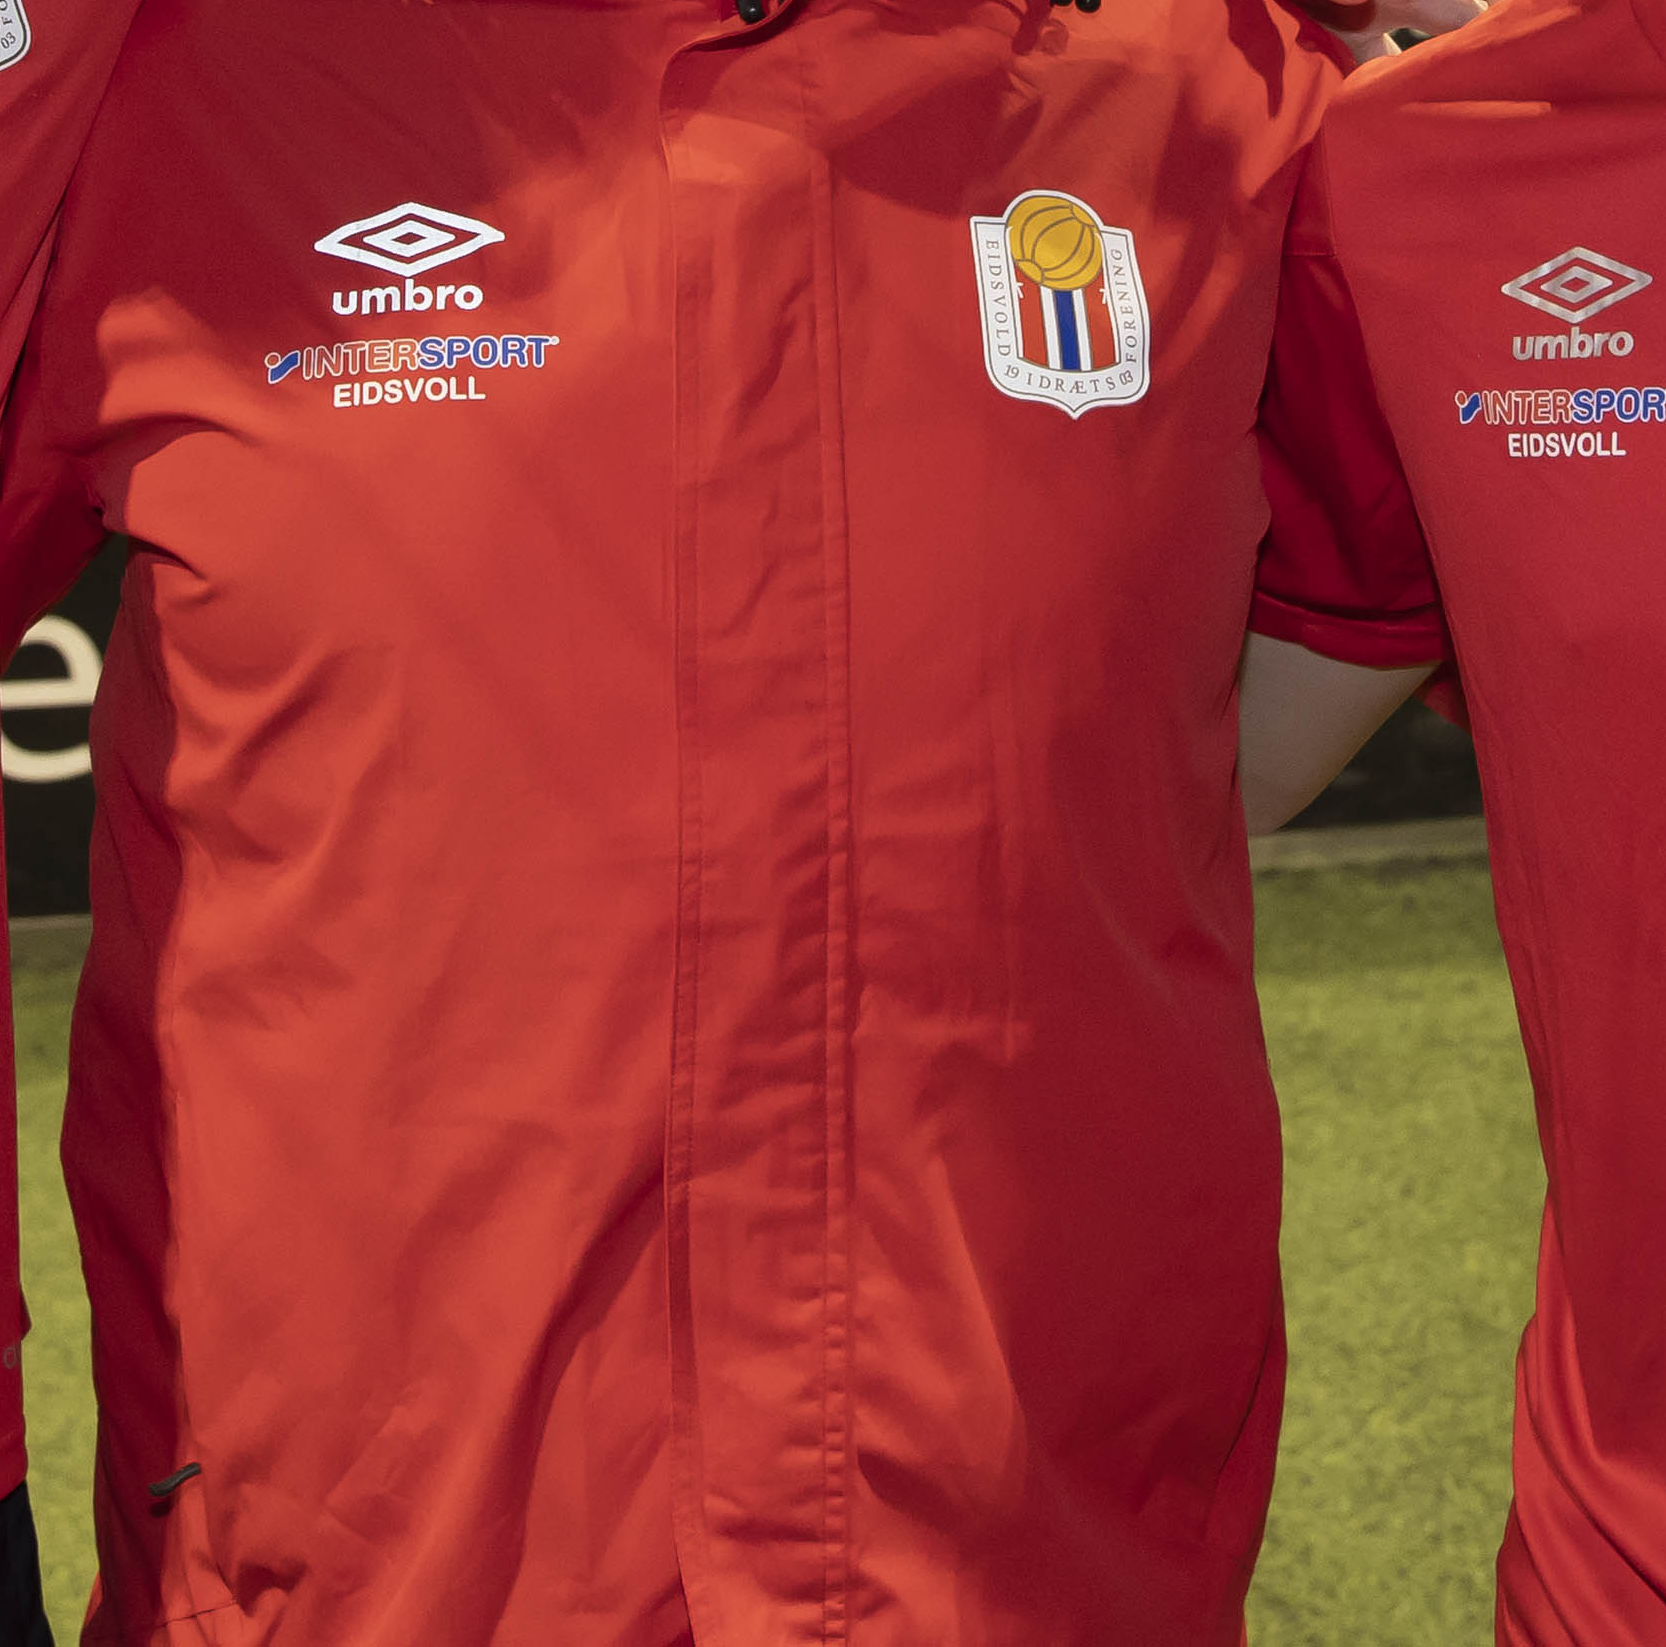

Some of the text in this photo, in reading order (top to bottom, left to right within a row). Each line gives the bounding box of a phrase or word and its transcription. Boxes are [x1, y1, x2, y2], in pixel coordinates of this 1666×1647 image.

[332, 278, 484, 315] umbro
[985, 239, 1011, 357] EIDSVOLD
[1110, 248, 1138, 363] FORENING
[302, 335, 552, 380] INTERSPORT
[1512, 327, 1634, 361] umbro
[333, 376, 486, 407] EIDSVOLL
[1507, 431, 1627, 457] EIDSVOLL
